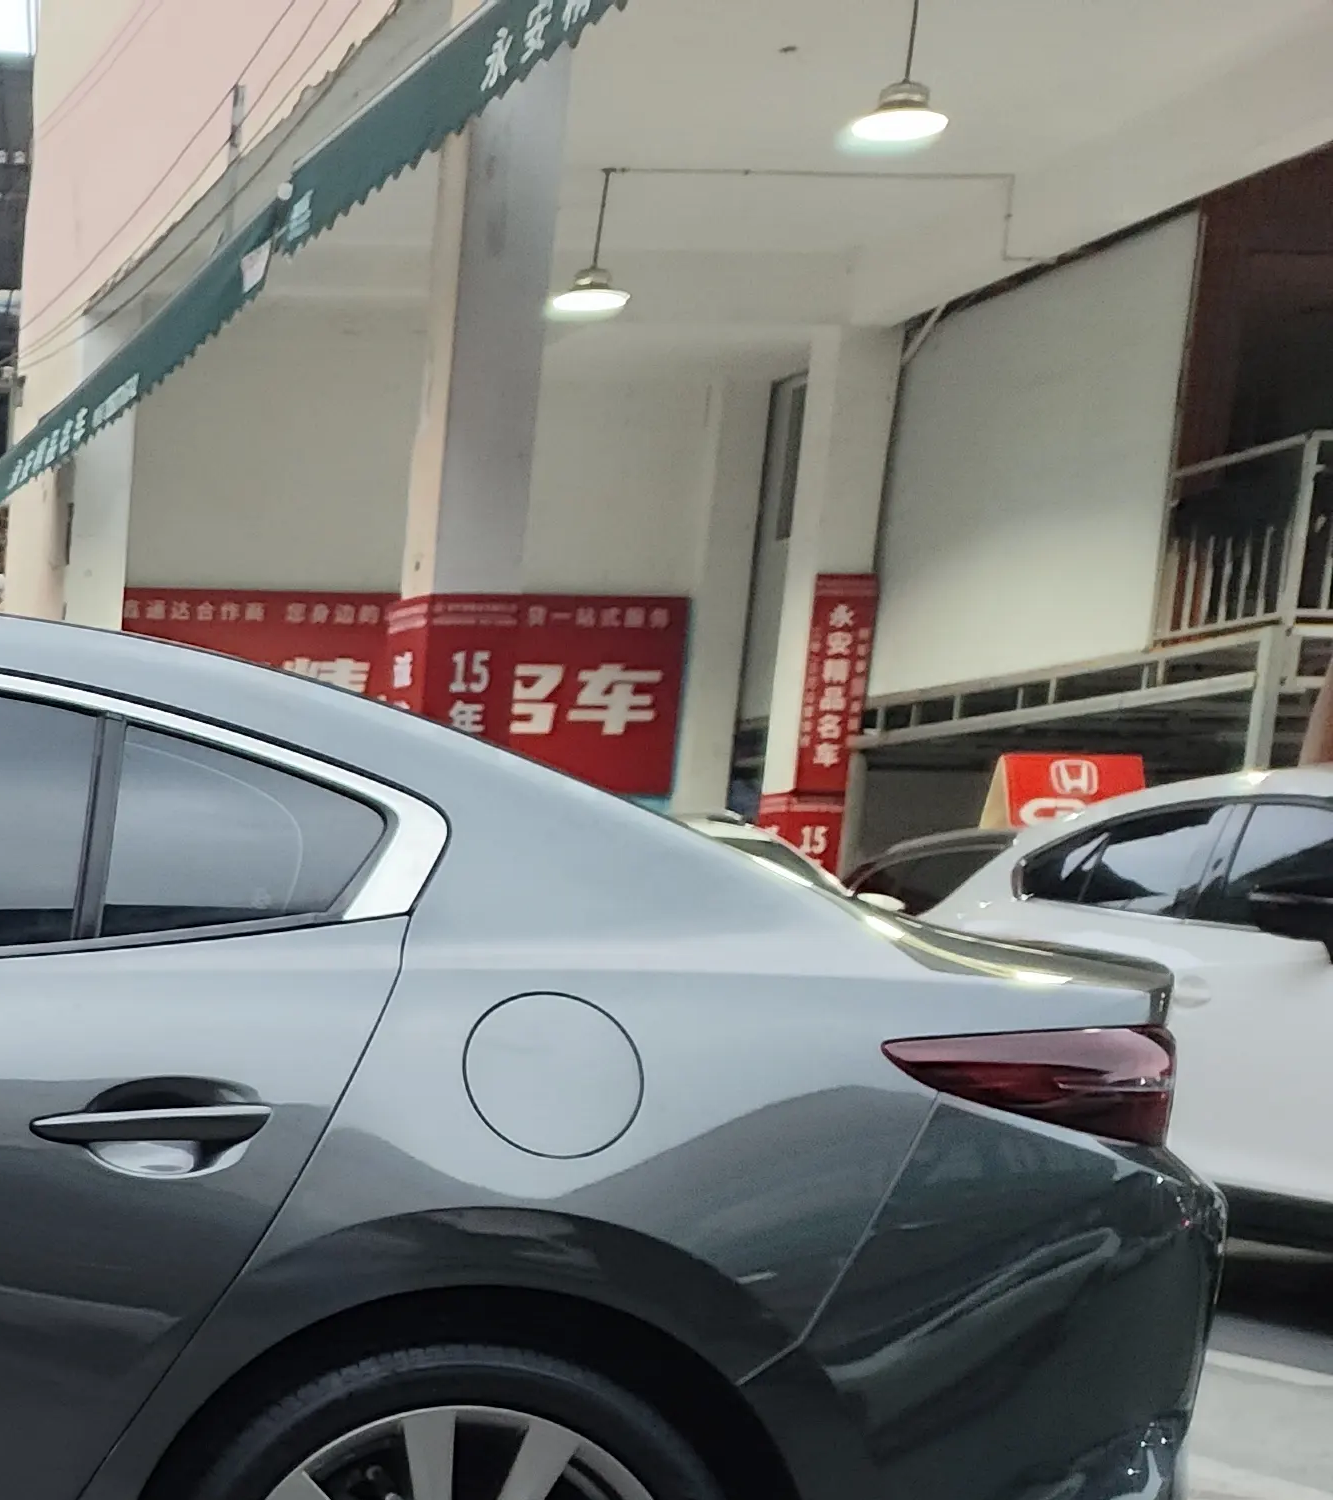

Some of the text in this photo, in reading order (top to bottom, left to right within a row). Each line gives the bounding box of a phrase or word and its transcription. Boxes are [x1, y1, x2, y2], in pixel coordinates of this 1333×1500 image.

[813, 603, 854, 768] 永安精品名车
